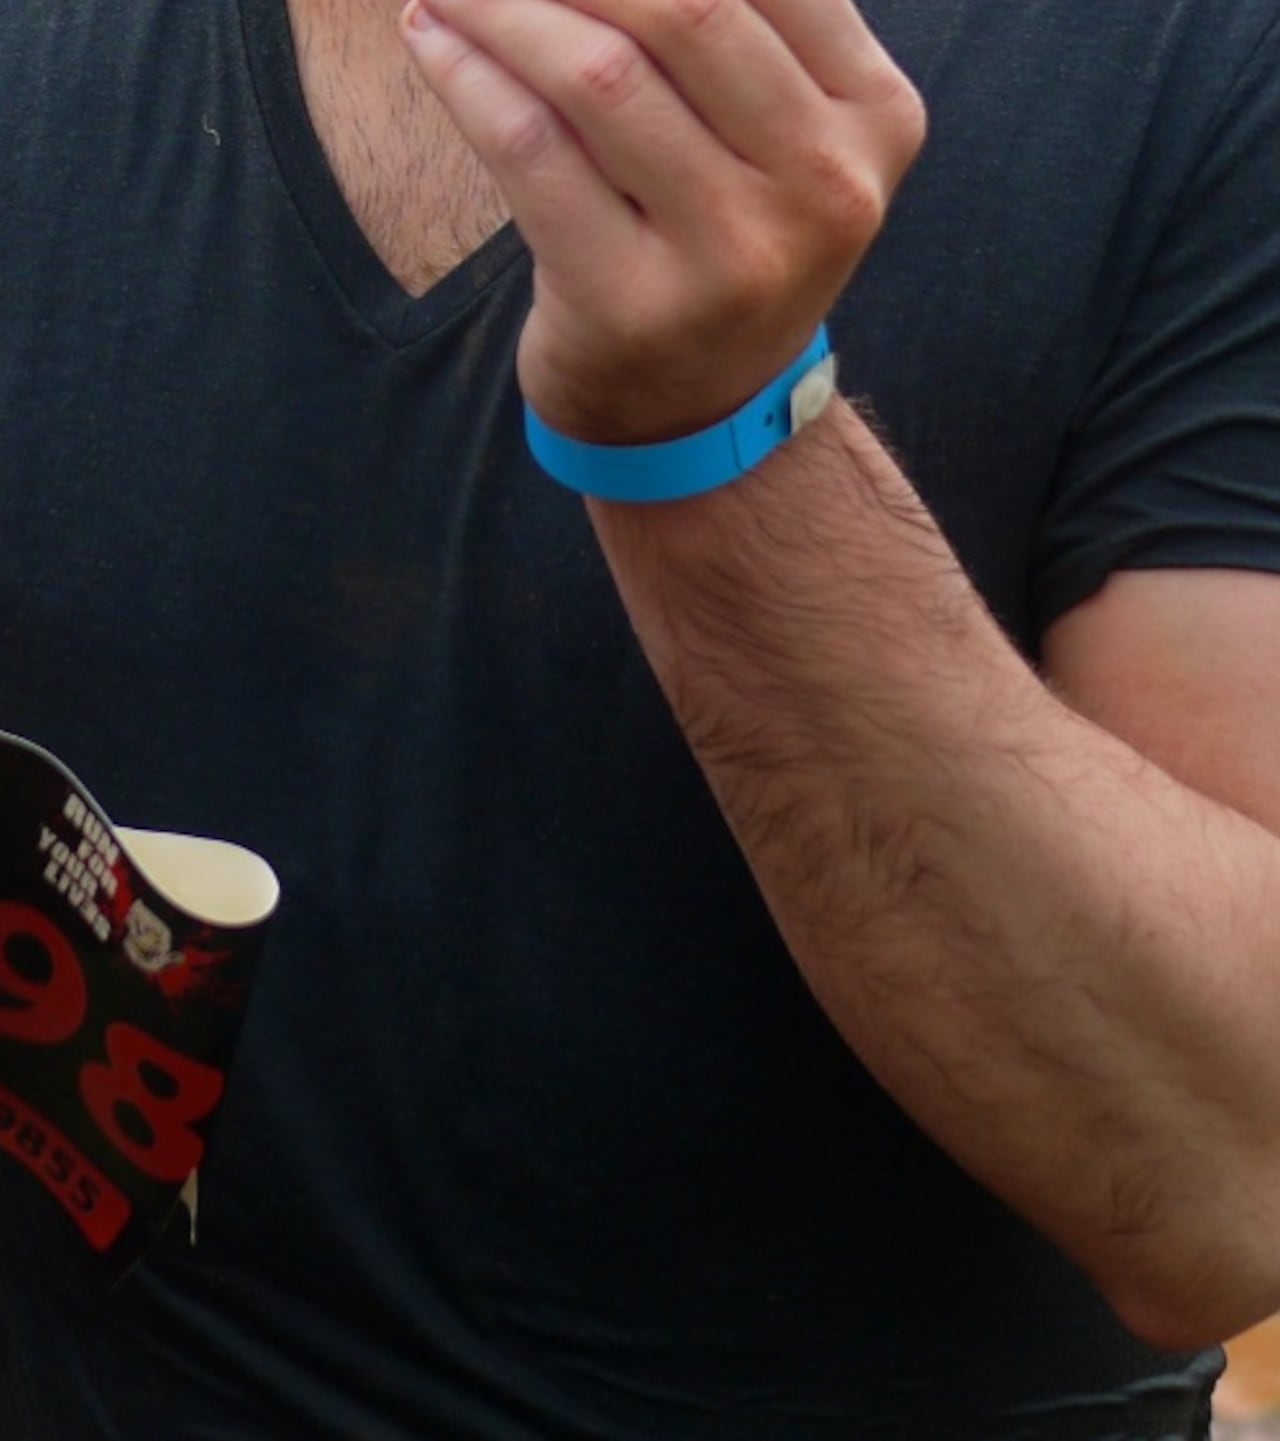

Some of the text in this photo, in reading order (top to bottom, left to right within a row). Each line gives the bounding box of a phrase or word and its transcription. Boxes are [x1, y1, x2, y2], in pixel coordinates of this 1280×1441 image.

[38, 826, 99, 899] YOUR
[63, 792, 120, 866] RUN
[43, 861, 111, 942] LIVES
[77, 839, 119, 898] FOR
